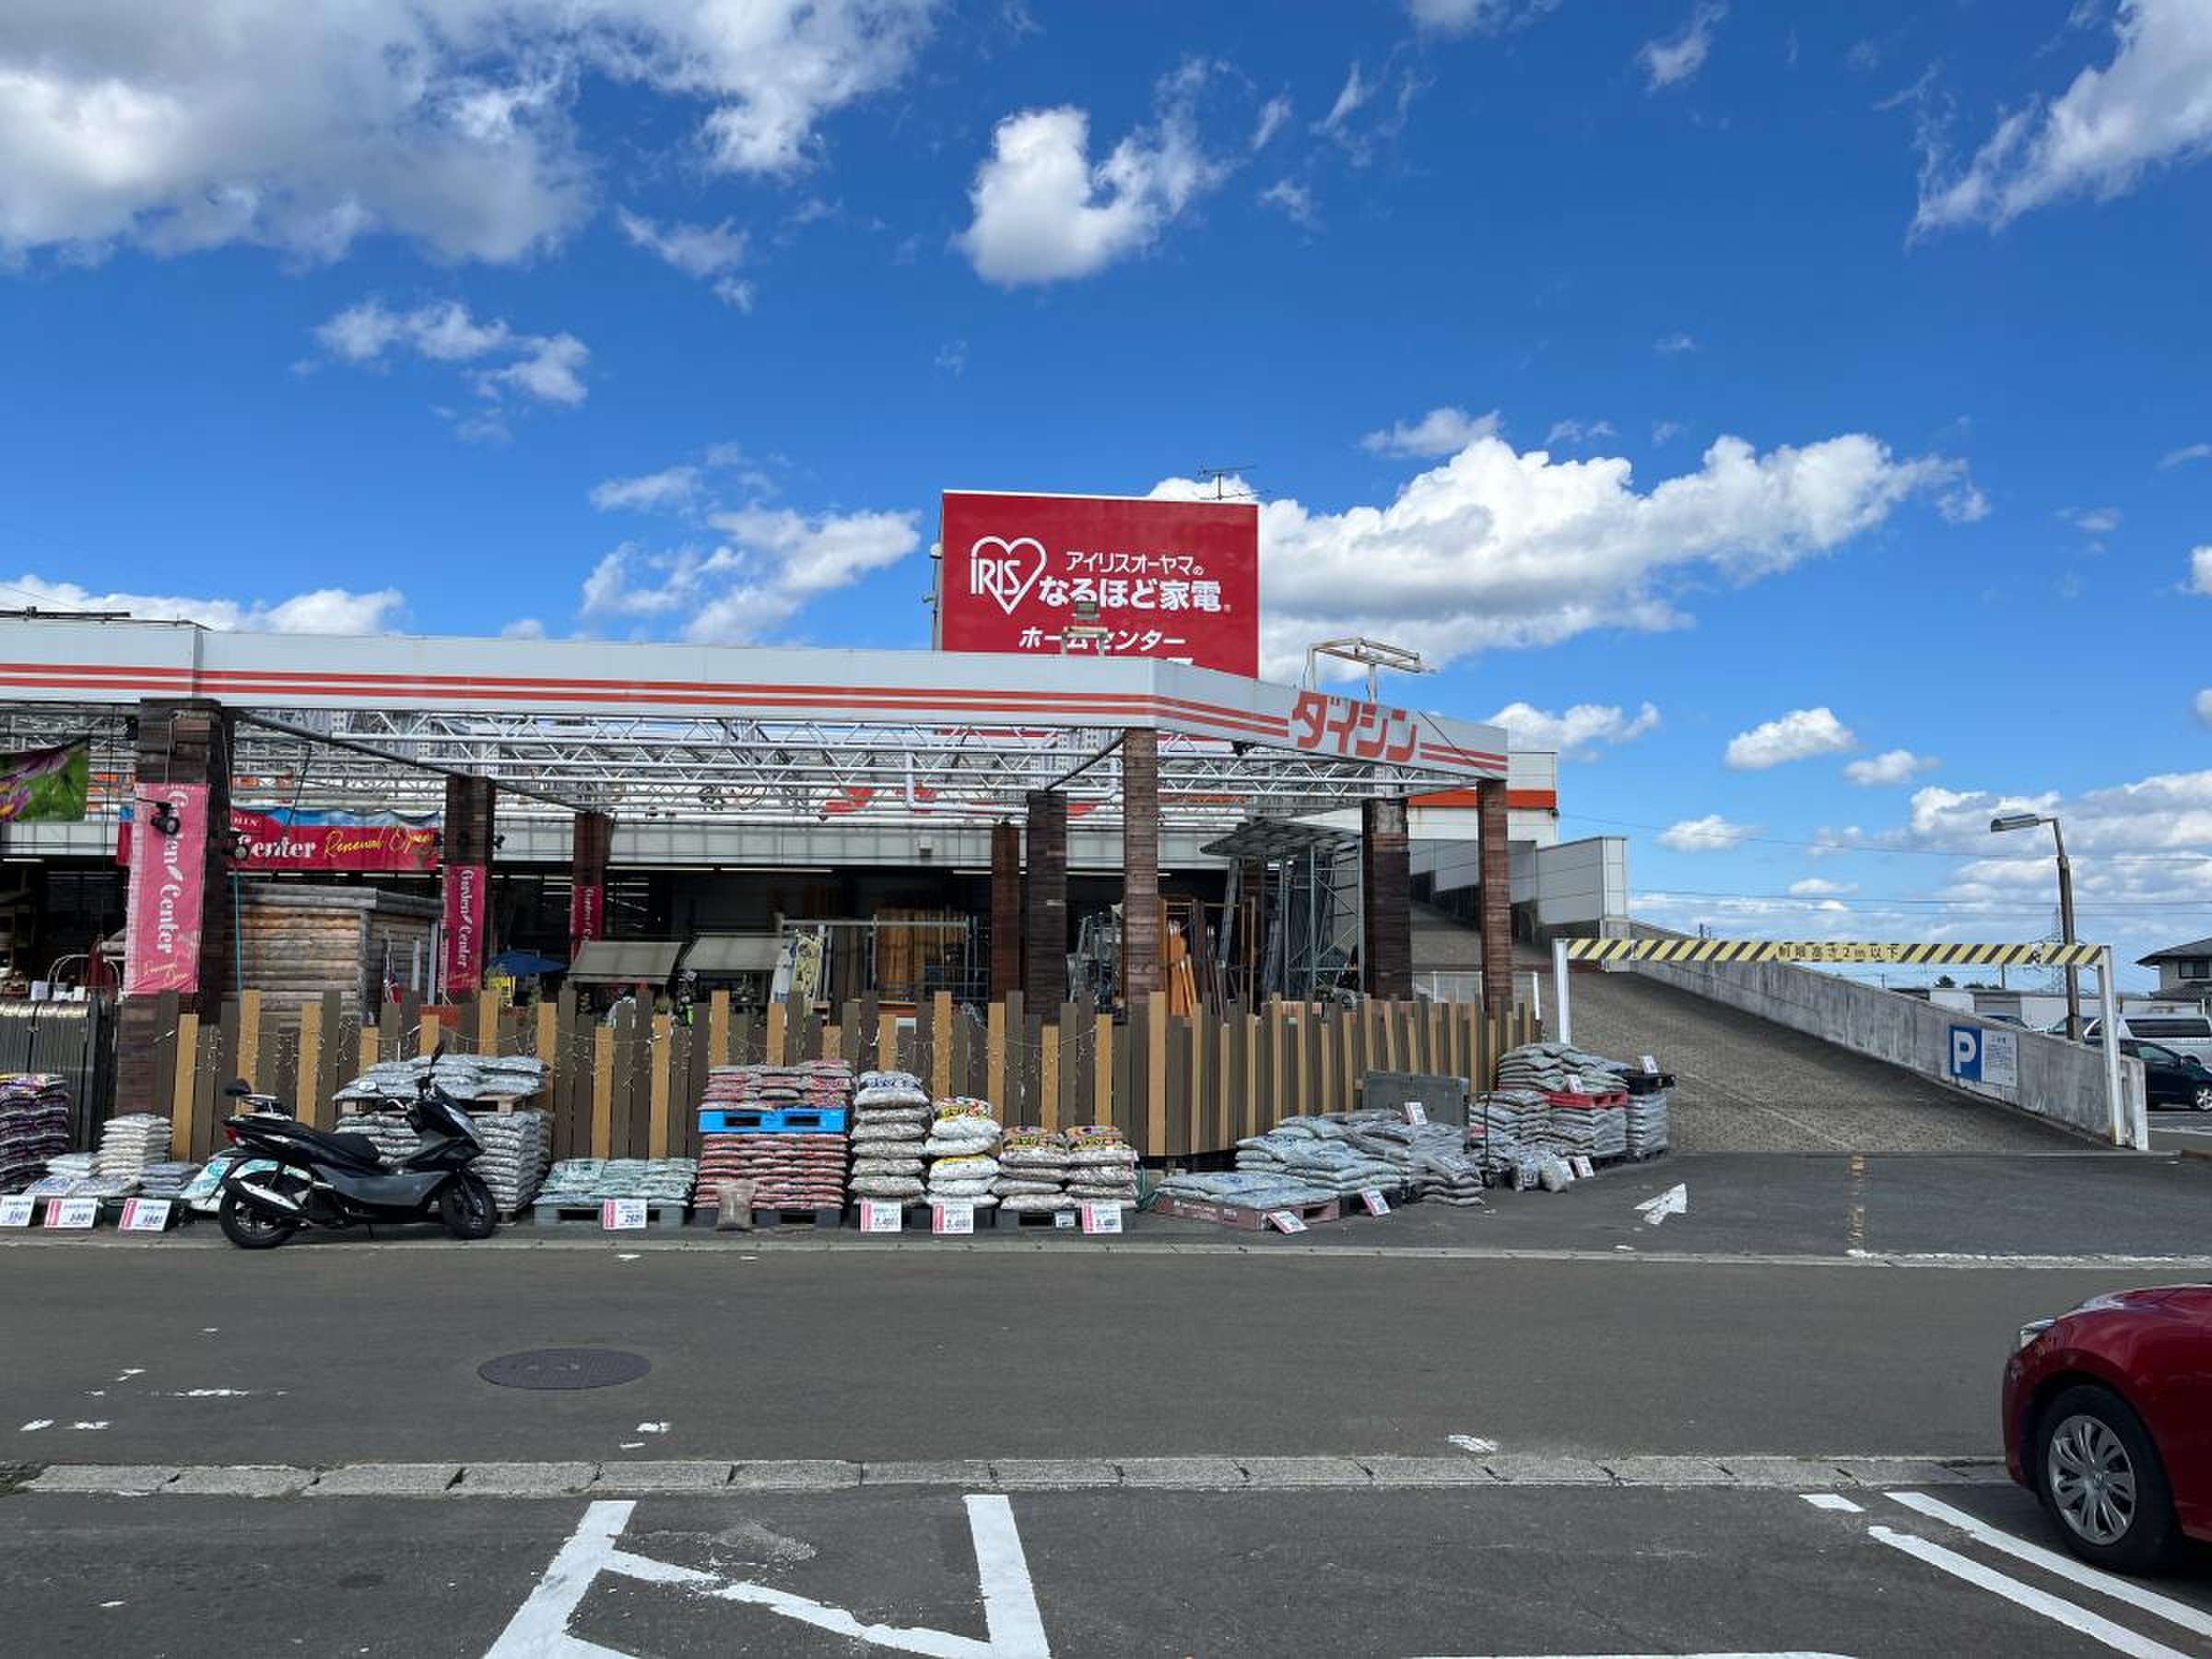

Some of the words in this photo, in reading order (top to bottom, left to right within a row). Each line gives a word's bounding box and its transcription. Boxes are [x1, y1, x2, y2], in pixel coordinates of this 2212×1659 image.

[971, 558, 1021, 595] IRIS
[1065, 551, 1205, 577] アイリスオーヤマの
[1039, 575, 1222, 613] なるほど家電
[1292, 690, 1417, 763] ダイシン
[157, 884, 182, 955] Center
[1953, 1030, 1977, 1075] P
